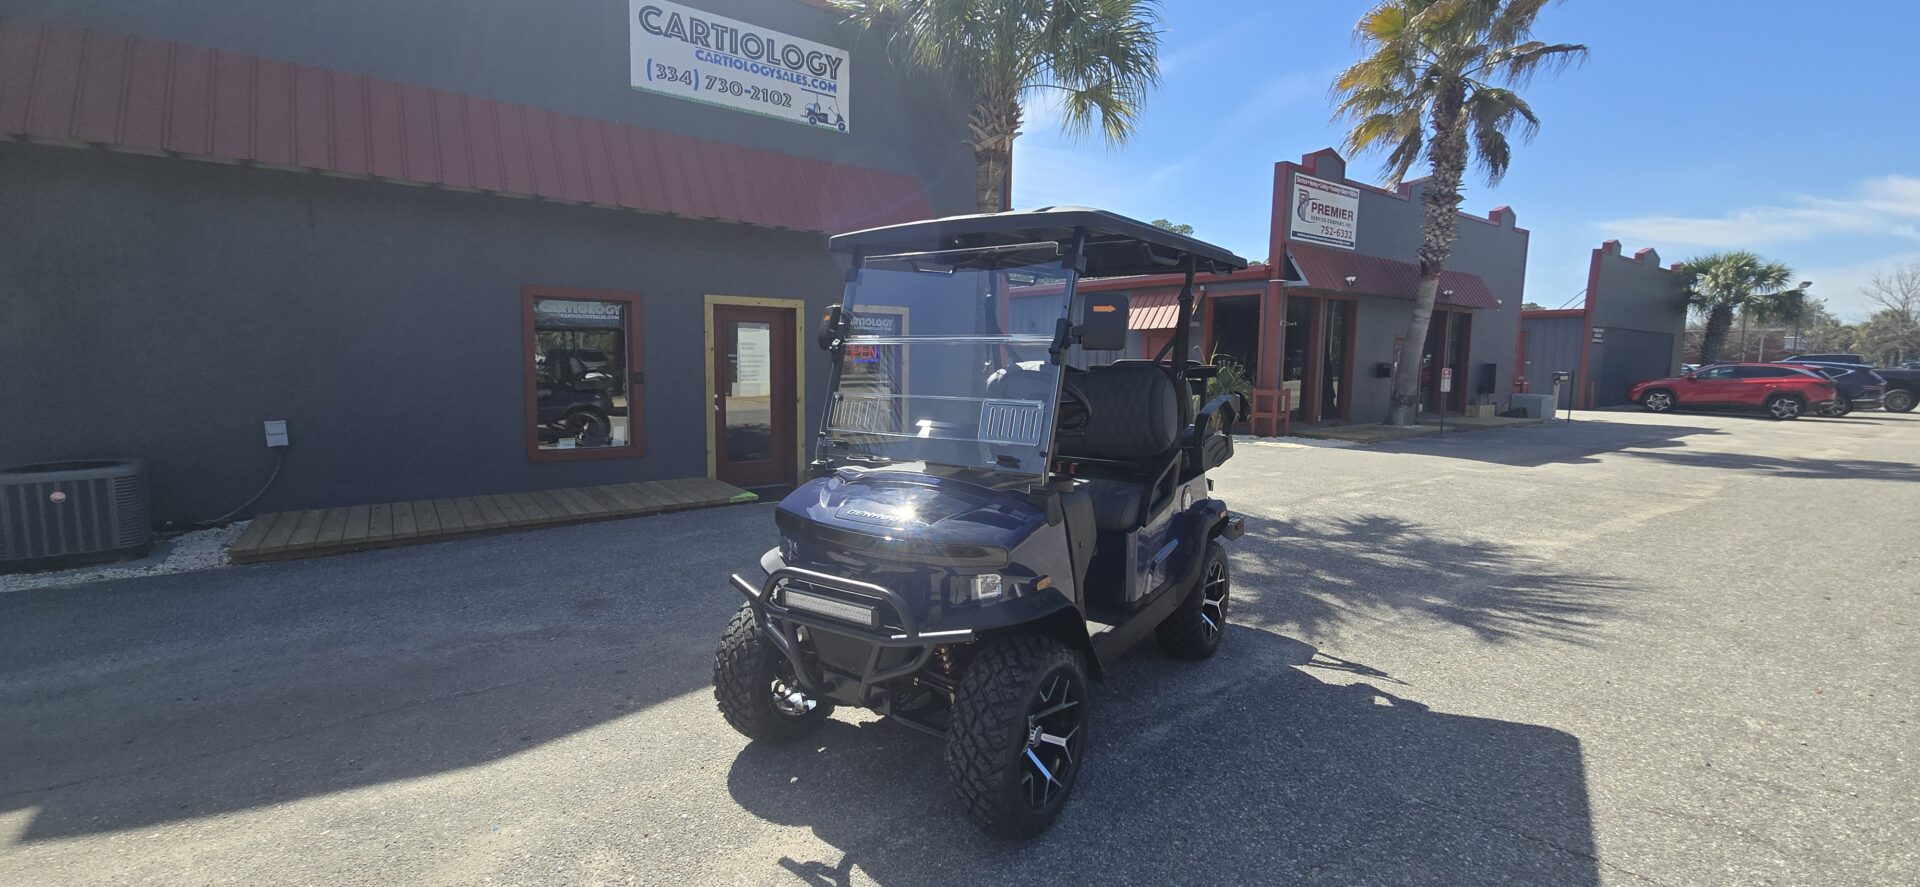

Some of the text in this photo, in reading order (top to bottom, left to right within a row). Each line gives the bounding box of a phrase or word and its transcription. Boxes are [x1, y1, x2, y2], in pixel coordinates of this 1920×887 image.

[638, 5, 843, 80] CARTIOLOGY
[646, 58, 792, 108] (334) 730-2102
[695, 49, 838, 94] CARTIOLOGYSALES.COM
[1311, 202, 1354, 222] PREMIER
[1320, 225, 1353, 239] 752-6332
